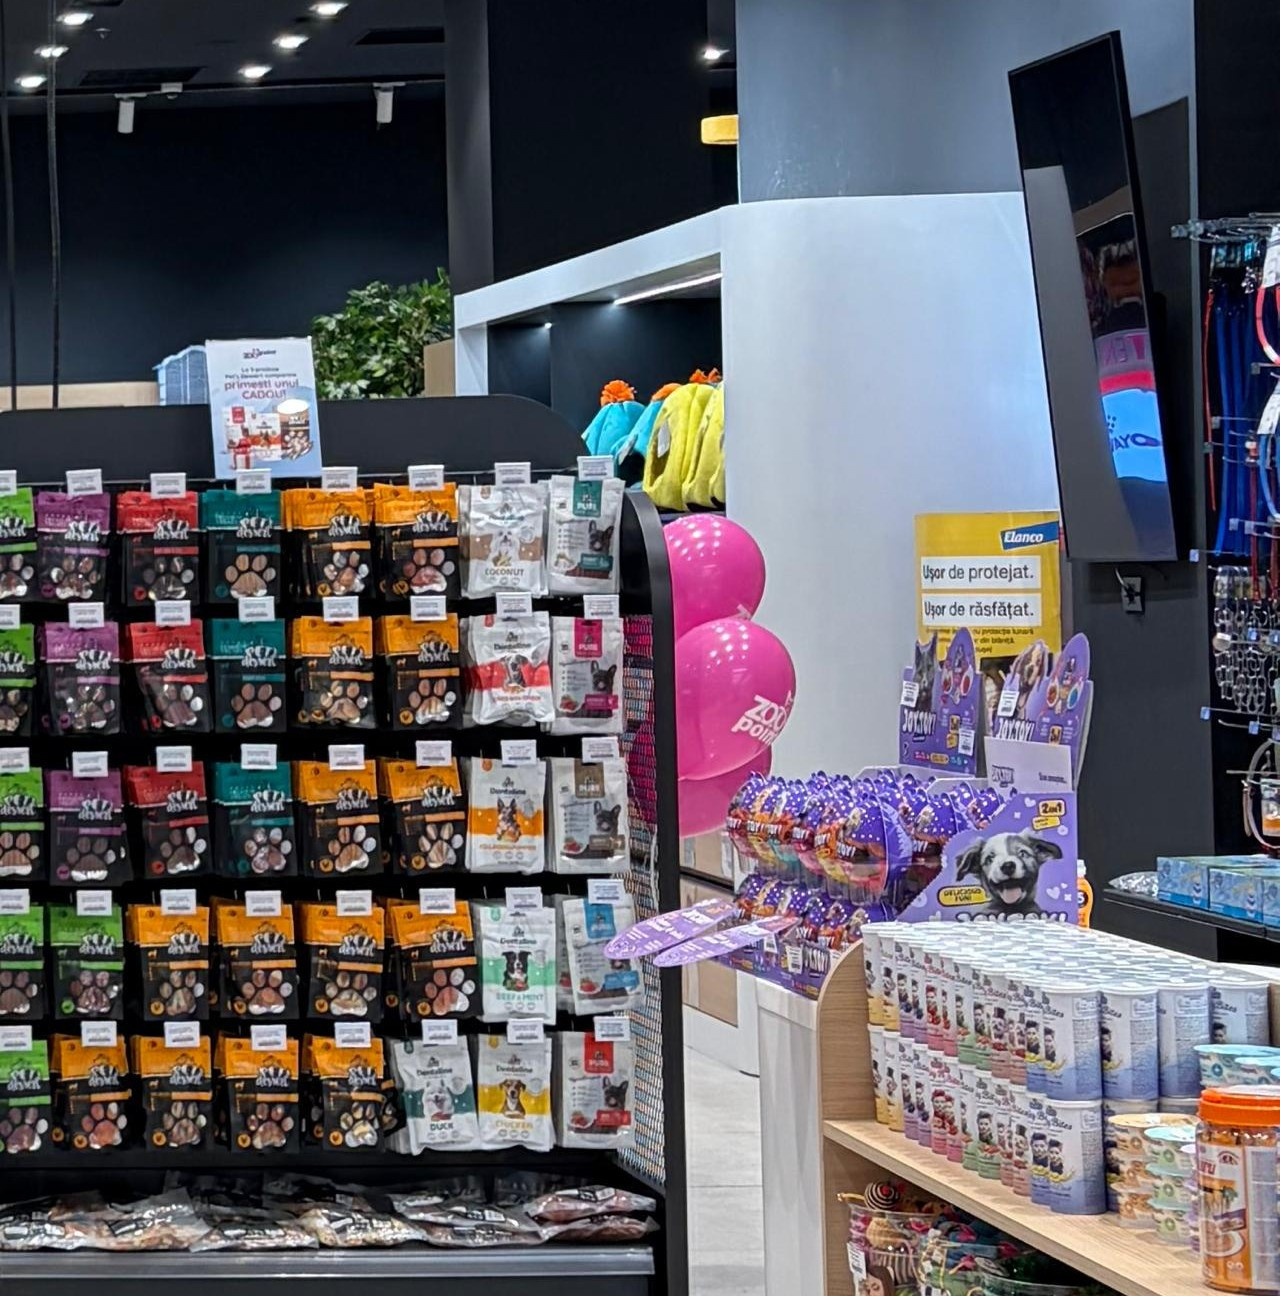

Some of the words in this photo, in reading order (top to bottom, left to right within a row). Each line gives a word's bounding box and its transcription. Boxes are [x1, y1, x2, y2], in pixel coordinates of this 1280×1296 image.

[1003, 530, 1044, 544] Elanco
[485, 568, 524, 577] COCONUT
[948, 565, 964, 579] de
[968, 564, 1034, 582] protejat.
[948, 600, 965, 615] de
[430, 1123, 454, 1131] DUCK
